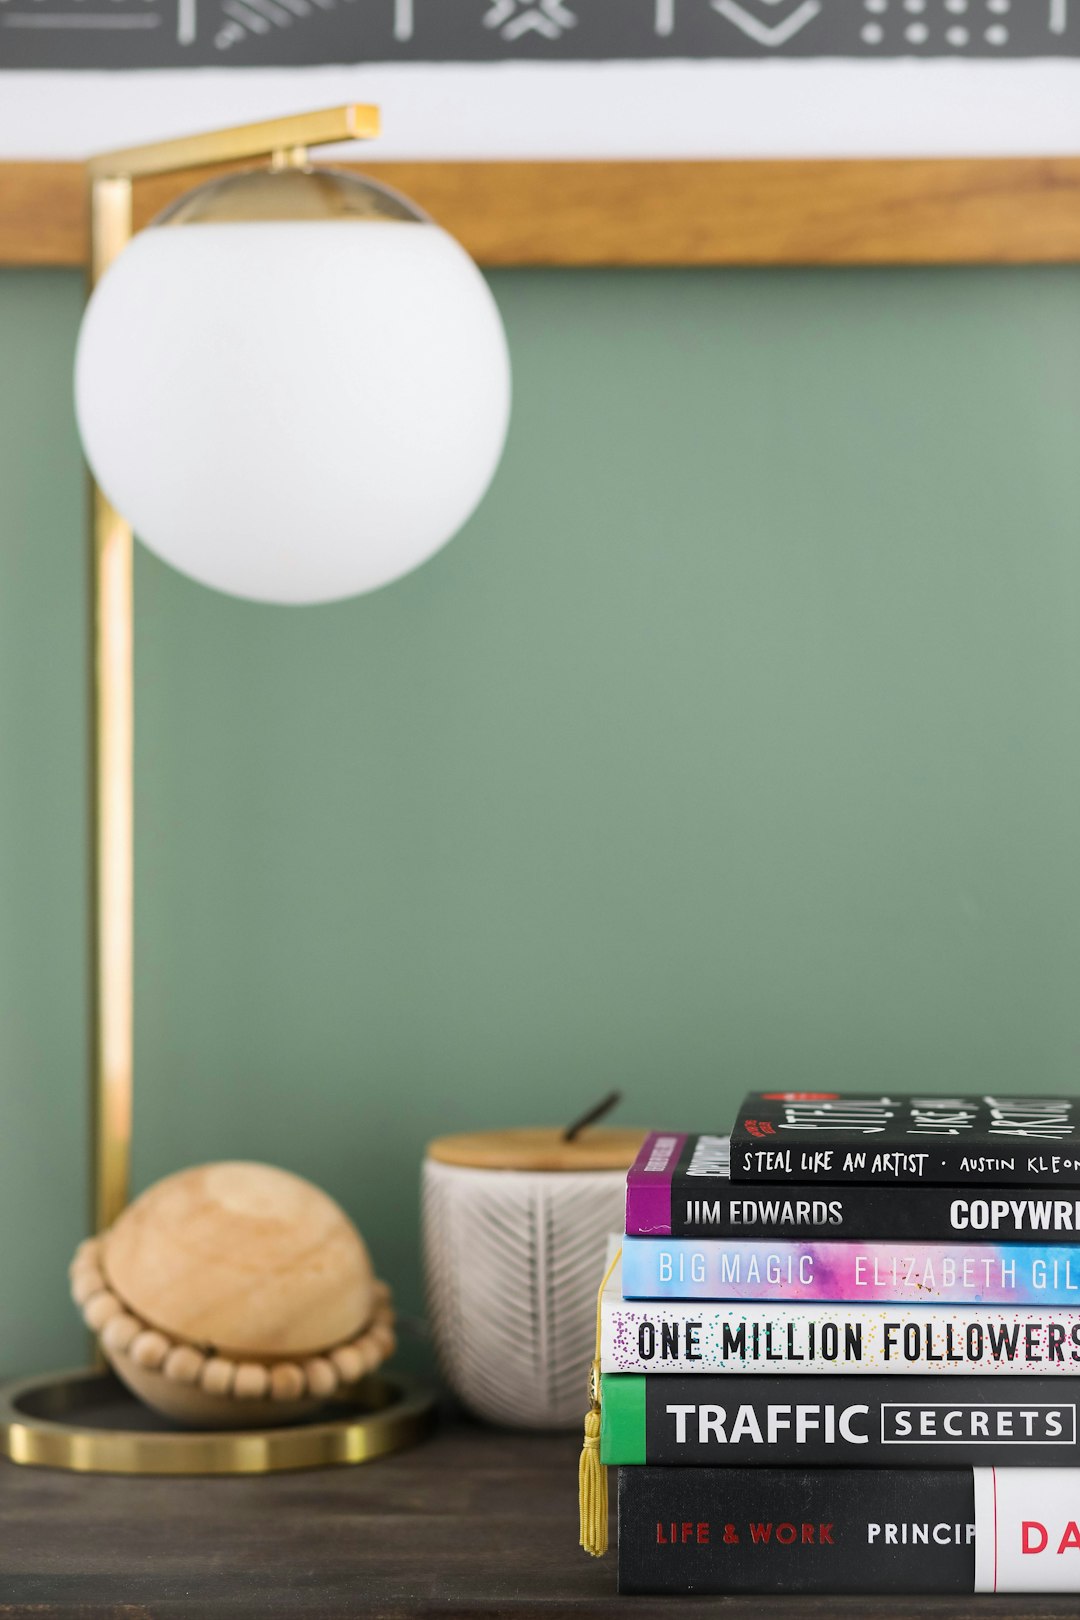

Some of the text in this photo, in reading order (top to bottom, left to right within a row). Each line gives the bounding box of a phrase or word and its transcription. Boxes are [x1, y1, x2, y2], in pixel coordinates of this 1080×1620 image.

[743, 1150, 792, 1173] STEAL
[801, 1151, 833, 1173] LIKE
[843, 1152, 866, 1172] AN
[872, 1152, 929, 1177] ARTIST
[960, 1157, 1015, 1172] AUSTIN
[684, 1201, 721, 1226] JIM
[730, 1201, 843, 1226] EDWARDS
[659, 1253, 1078, 1290] BIG MAGIC ELIZABETH GIL
[638, 1322, 702, 1361] ONE
[722, 1322, 862, 1361] MILLION
[666, 1404, 1063, 1444] TRAFFIC SECRETS
[656, 1523, 710, 1544] LIFE
[723, 1523, 739, 1545] &
[750, 1523, 835, 1545] WORK
[1022, 1521, 1080, 1555] DA
